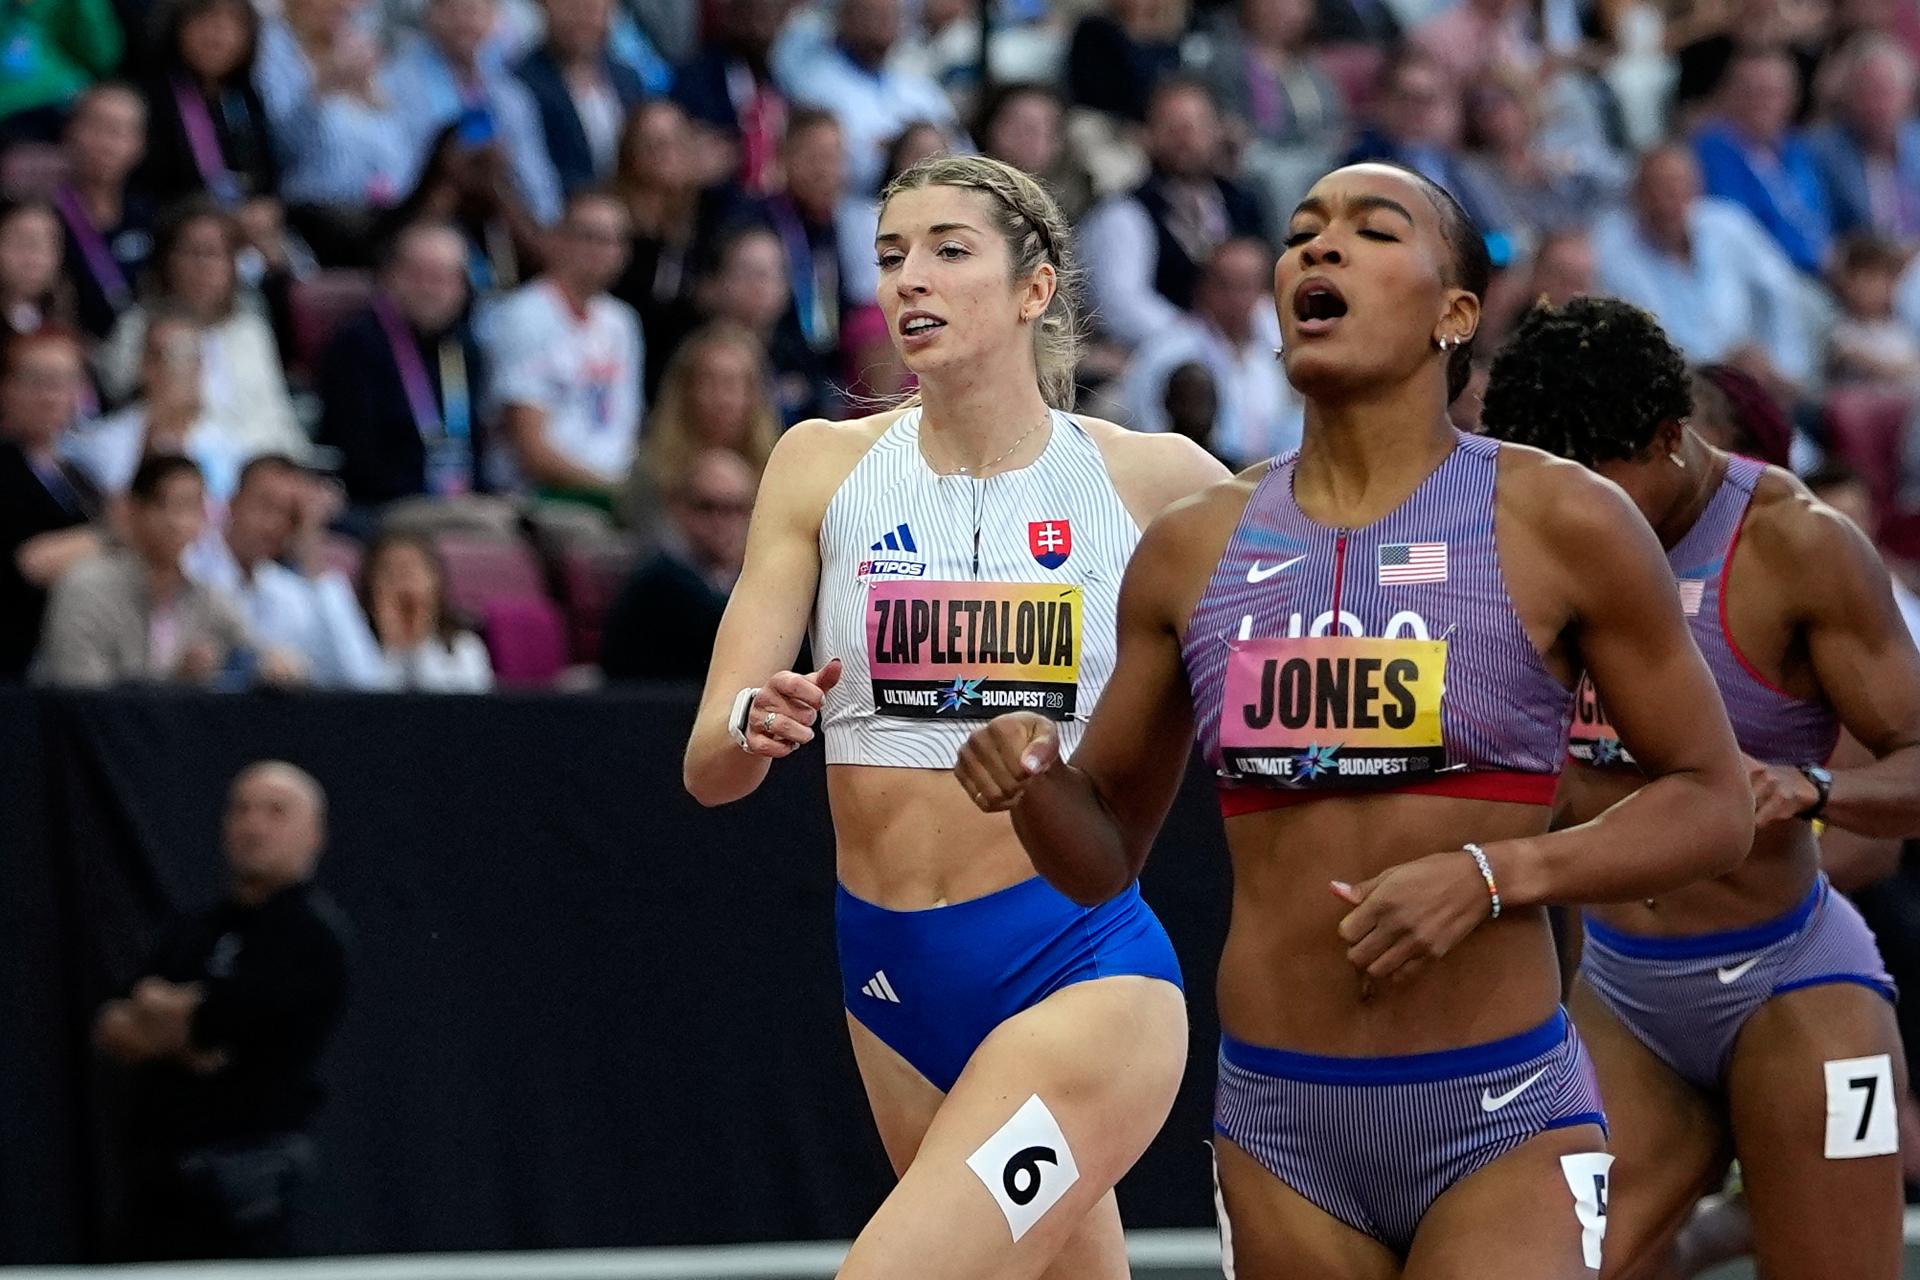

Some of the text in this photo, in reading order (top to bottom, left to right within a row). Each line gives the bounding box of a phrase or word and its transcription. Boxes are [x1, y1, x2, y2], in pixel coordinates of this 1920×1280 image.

[873, 561, 923, 575] TIPOS
[874, 599, 1073, 667] ZAPLETALOVA
[883, 689, 1064, 708] ULTIMATE BUDAPEST 26
[1243, 658, 1419, 730] JONES
[1236, 757, 1294, 775] ULTIMATE
[1338, 757, 1409, 775] BUDAPEST
[1849, 1076, 1878, 1141] 7
[1003, 1145, 1058, 1206] 6
